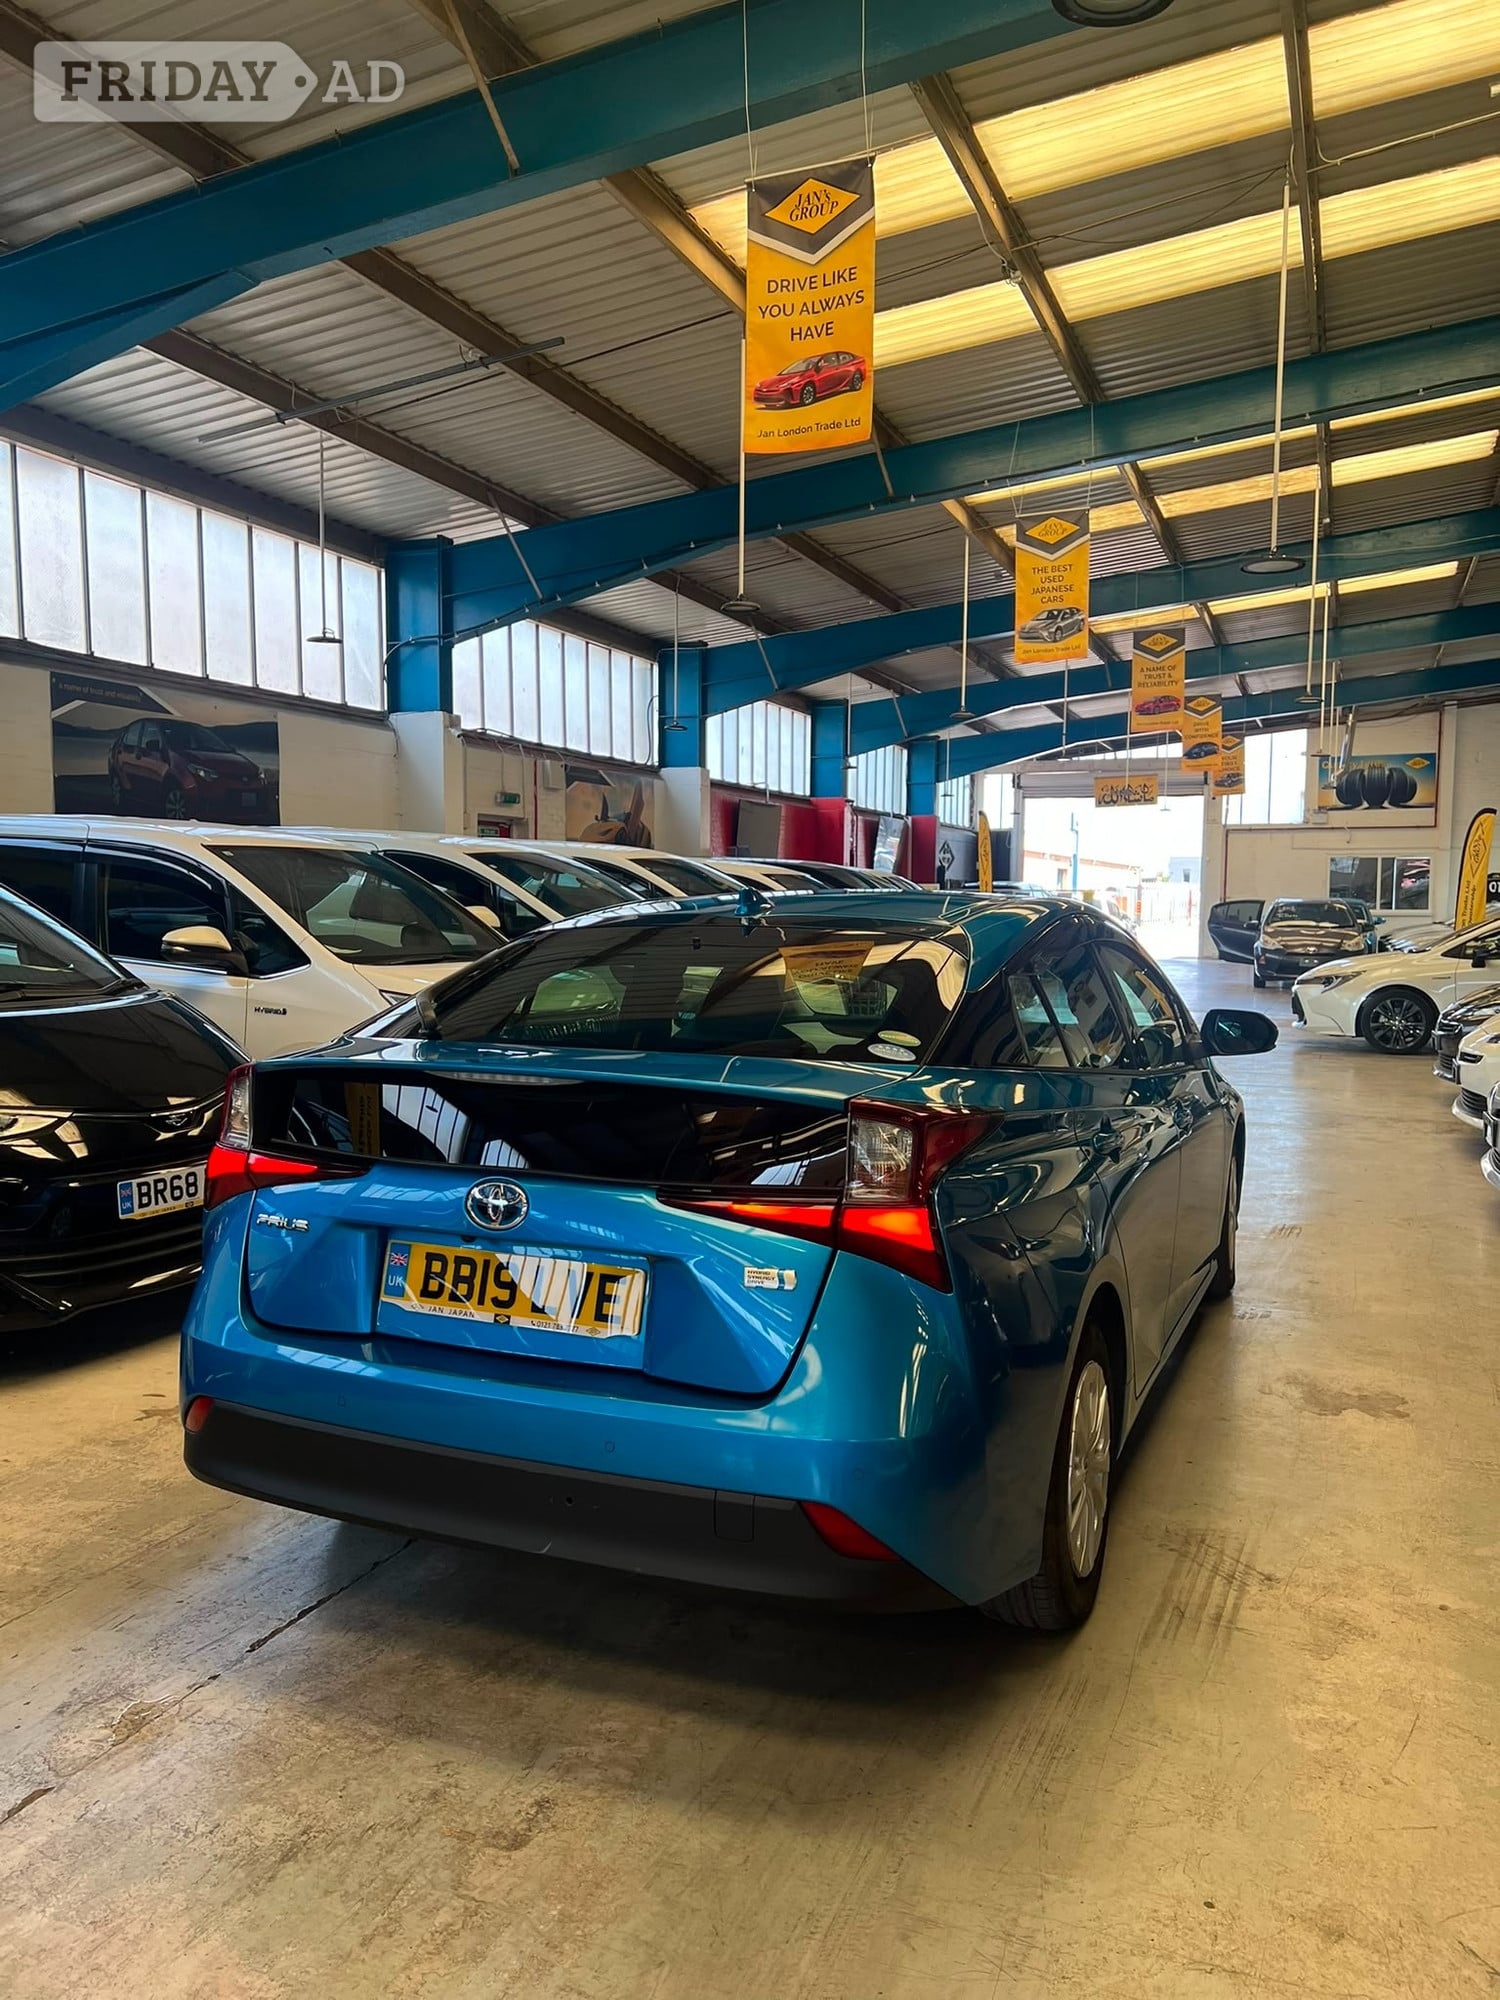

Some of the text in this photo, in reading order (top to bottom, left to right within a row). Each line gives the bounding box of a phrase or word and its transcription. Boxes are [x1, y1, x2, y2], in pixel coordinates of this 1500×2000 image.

[789, 200, 839, 222] GROUP
[767, 266, 858, 294] DRIVE LIKE
[758, 290, 865, 319] YOU ALWAYS
[790, 321, 835, 342] HAVE
[757, 417, 861, 438] Jan London Trade Ltd
[1032, 564, 1073, 575] THE BEST
[1040, 574, 1065, 584] USED
[1031, 584, 1075, 595] JAPANESE
[1040, 594, 1065, 604] CARS
[1137, 680, 1179, 688] RELIABILITY
[136, 1171, 198, 1210] BR68
[121, 1201, 132, 1209] UK
[256, 1213, 309, 1232] PRIUS
[387, 1274, 404, 1288] UK
[419, 1251, 519, 1309] BB19
[428, 1305, 475, 1319] JAN JAPAN
